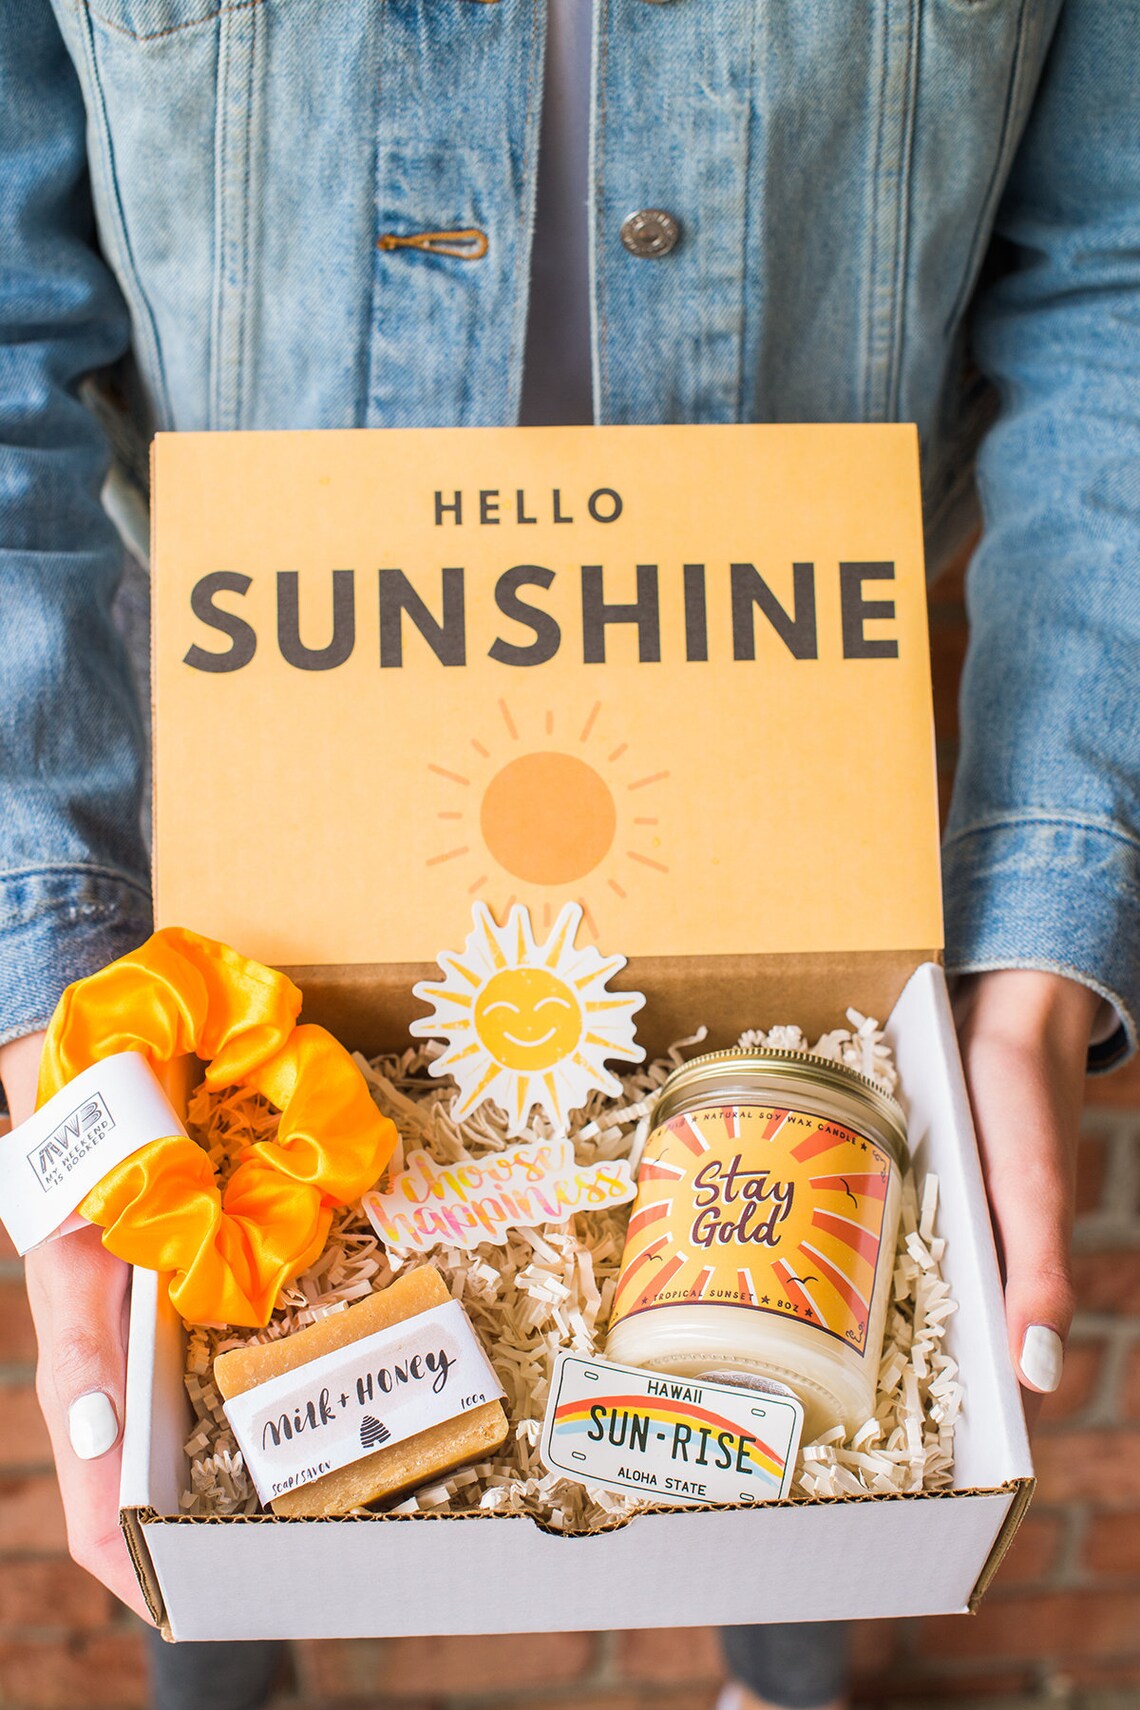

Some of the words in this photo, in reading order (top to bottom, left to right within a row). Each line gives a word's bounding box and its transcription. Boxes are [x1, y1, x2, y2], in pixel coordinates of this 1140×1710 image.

[434, 487, 624, 526] HELLO
[183, 561, 899, 673] SUNSHINE
[703, 1112, 753, 1121] NATURAL
[759, 1112, 782, 1121] SOY
[787, 1116, 812, 1127] WAX
[817, 1123, 857, 1145] CANDLE
[54, 1173, 64, 1186] IS
[66, 1131, 106, 1172] BOOKED
[370, 1165, 629, 1245] happiness
[695, 1154, 795, 1222] Stay
[692, 1200, 782, 1248] Gold
[653, 1290, 703, 1302] TROPICAL
[709, 1289, 754, 1302] SUNSET
[337, 1393, 350, 1408] +
[647, 1380, 703, 1404] HAWAII
[617, 1467, 657, 1486] ALOHA
[665, 1477, 707, 1497] STATE
